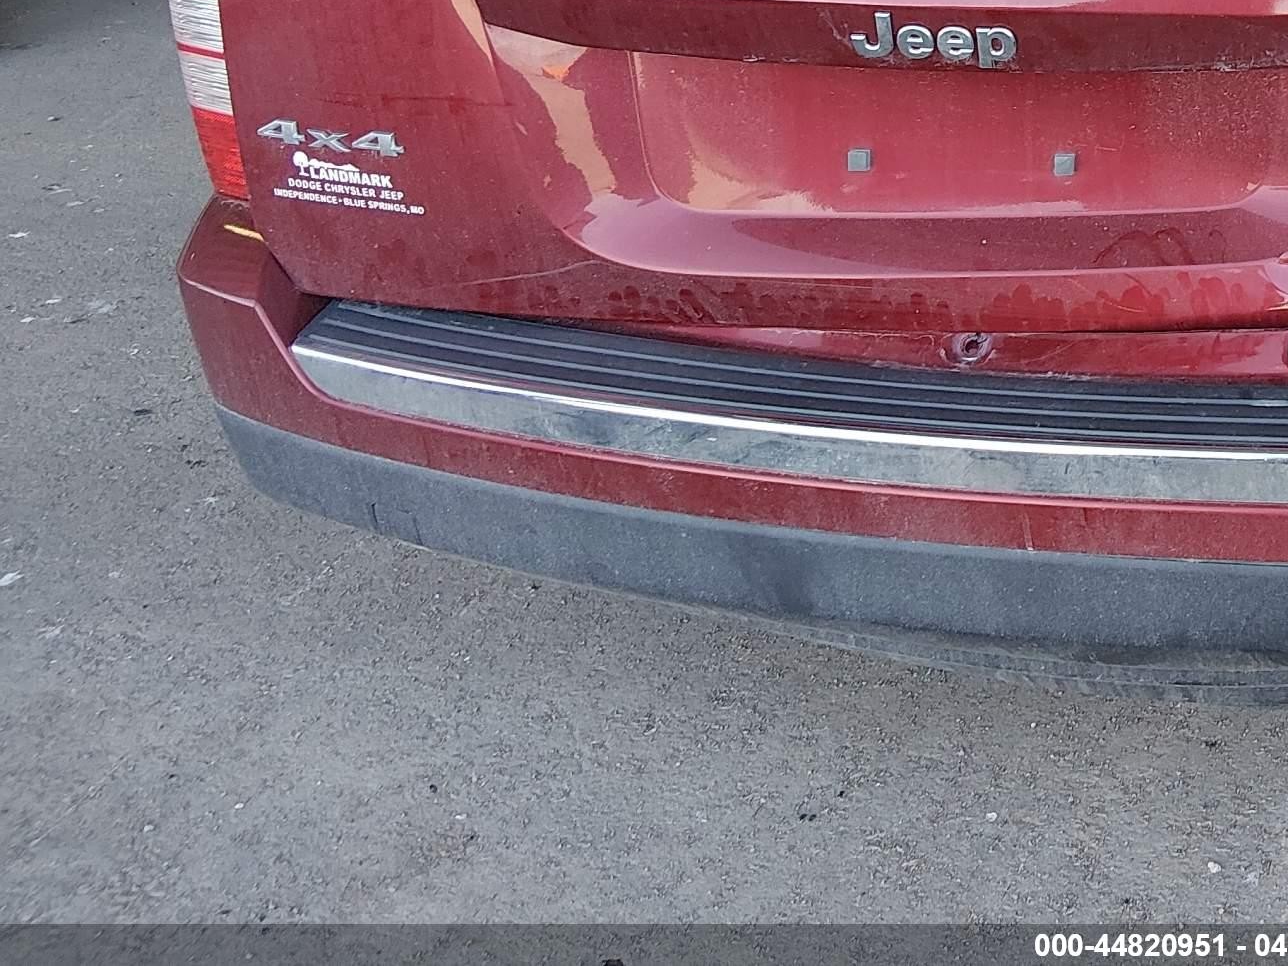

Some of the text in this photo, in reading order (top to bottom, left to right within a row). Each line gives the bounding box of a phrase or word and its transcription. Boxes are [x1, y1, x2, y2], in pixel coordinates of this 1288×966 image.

[850, 10, 1017, 68] Jeep
[288, 177, 405, 201] DODGE CHRYSLER JEEP
[309, 166, 394, 189] LANDMARK
[273, 188, 338, 204] INDEPENDENCE
[343, 197, 367, 208] BLUE
